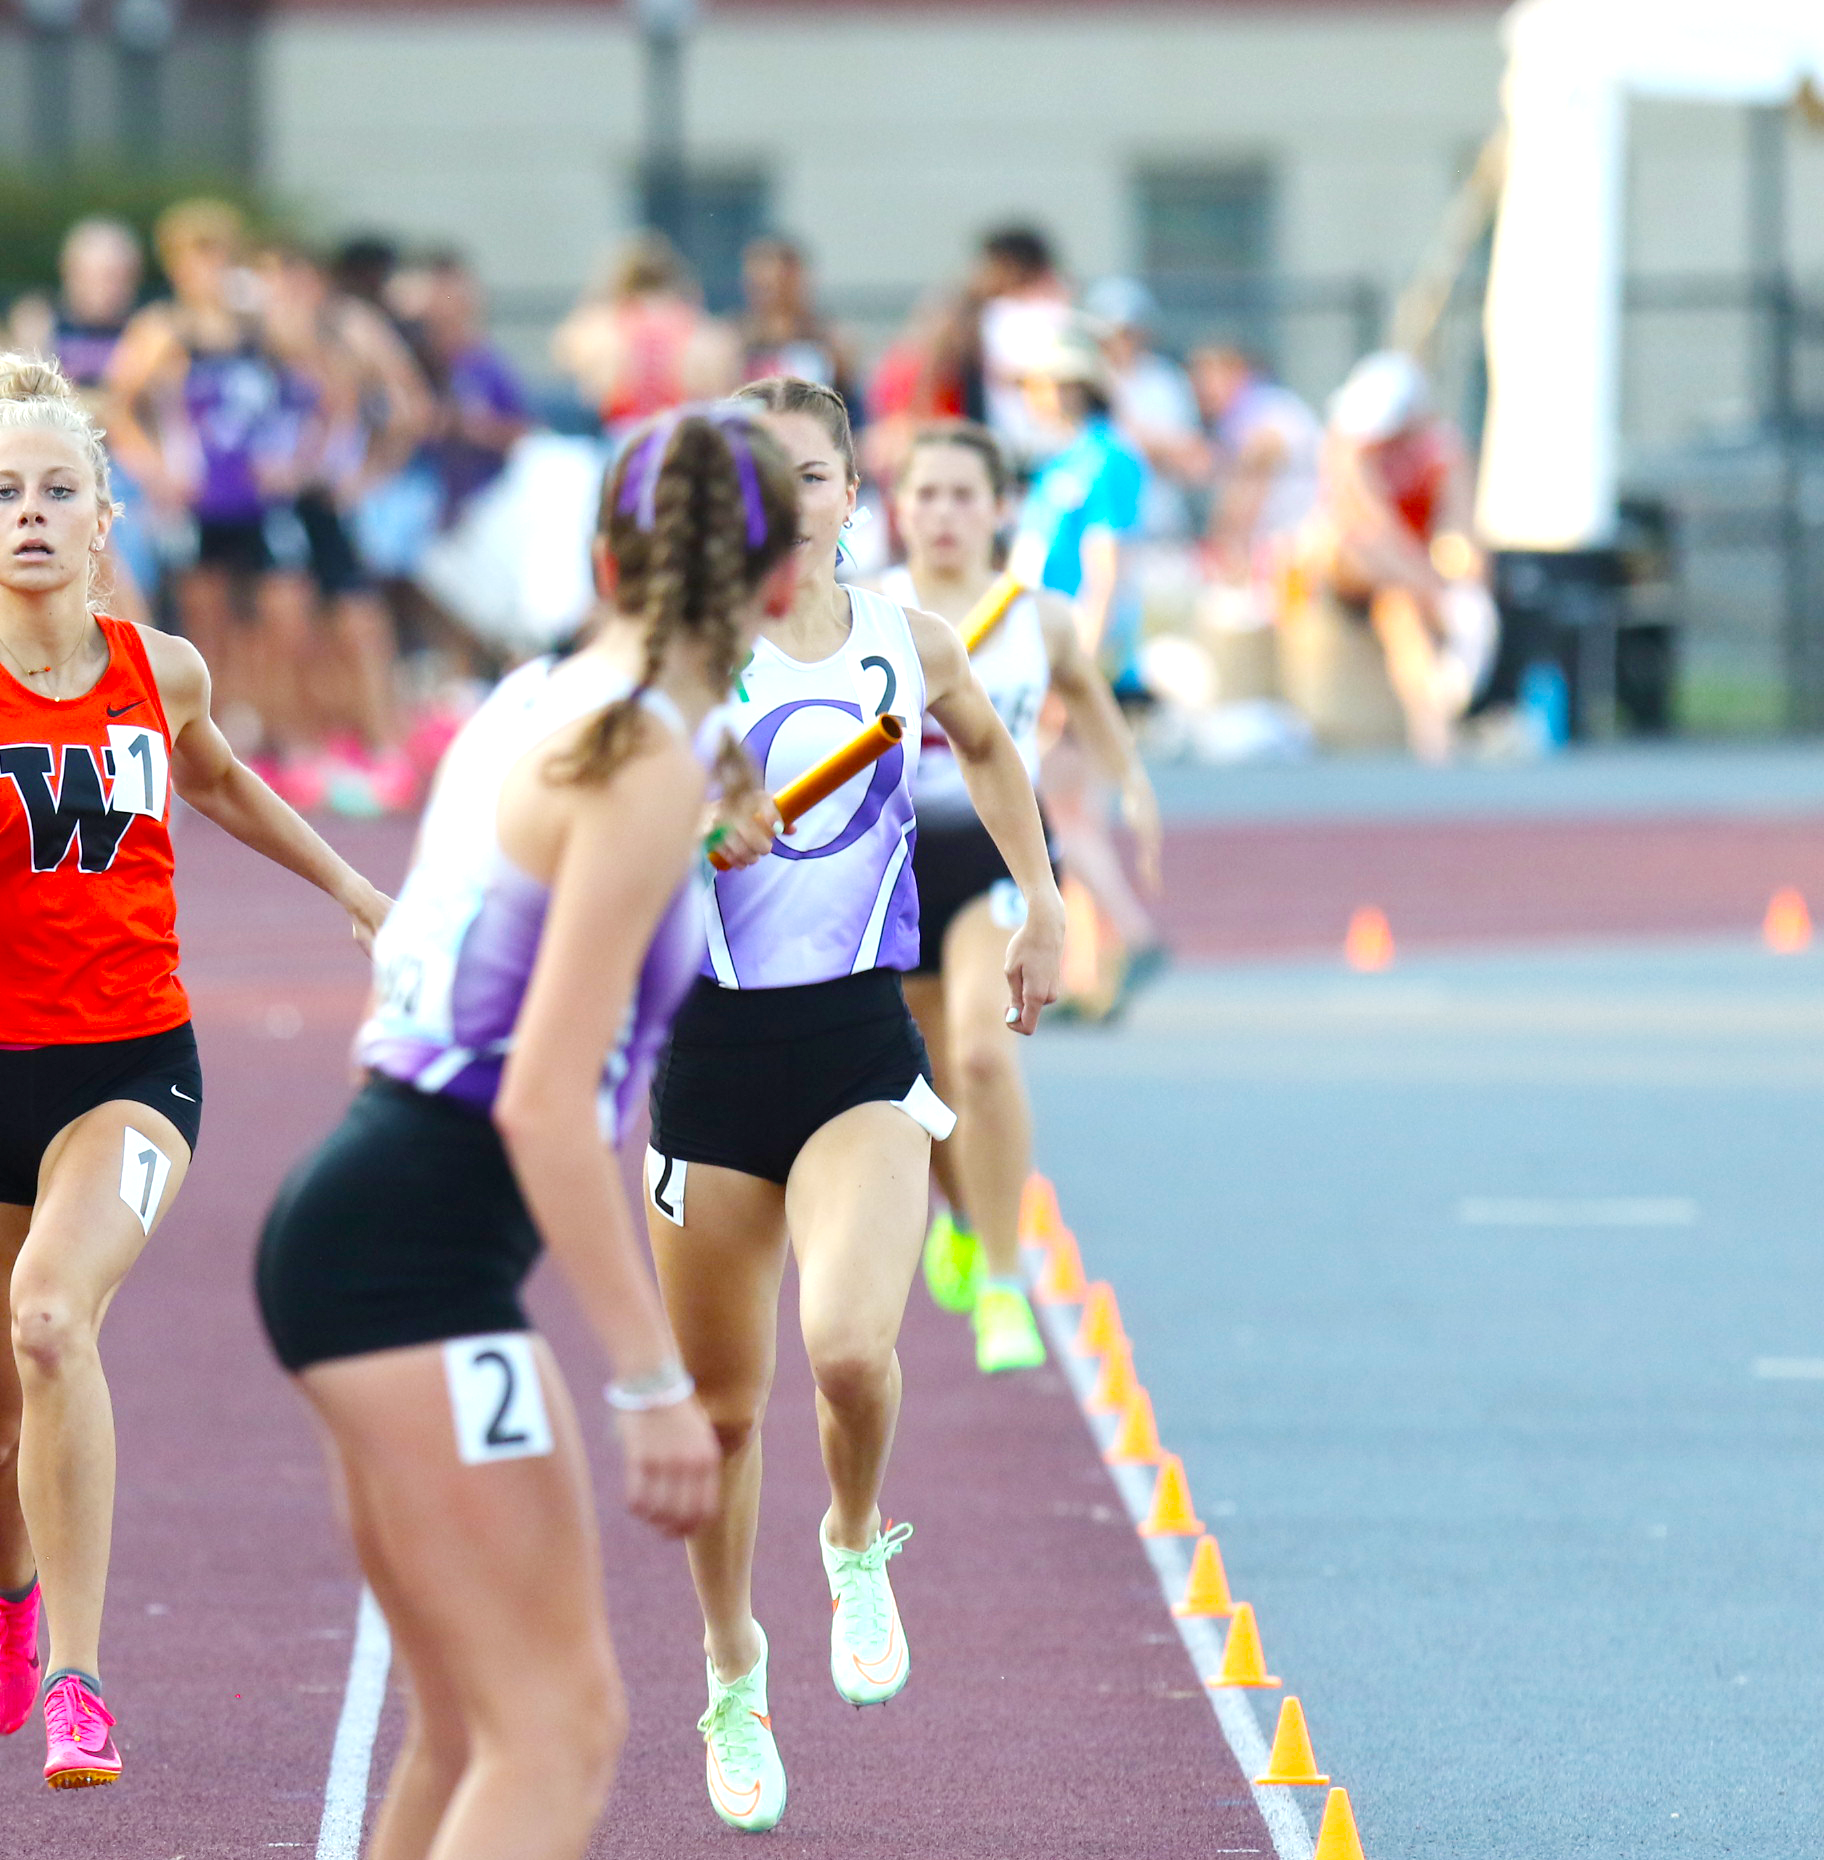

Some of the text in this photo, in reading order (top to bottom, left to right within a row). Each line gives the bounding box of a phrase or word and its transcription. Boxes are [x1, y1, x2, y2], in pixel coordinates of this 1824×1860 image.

[860, 656, 907, 728] 2
[128, 733, 154, 812] 1
[740, 698, 905, 861] O
[138, 1148, 158, 1219] 1
[473, 1350, 528, 1446] 2
